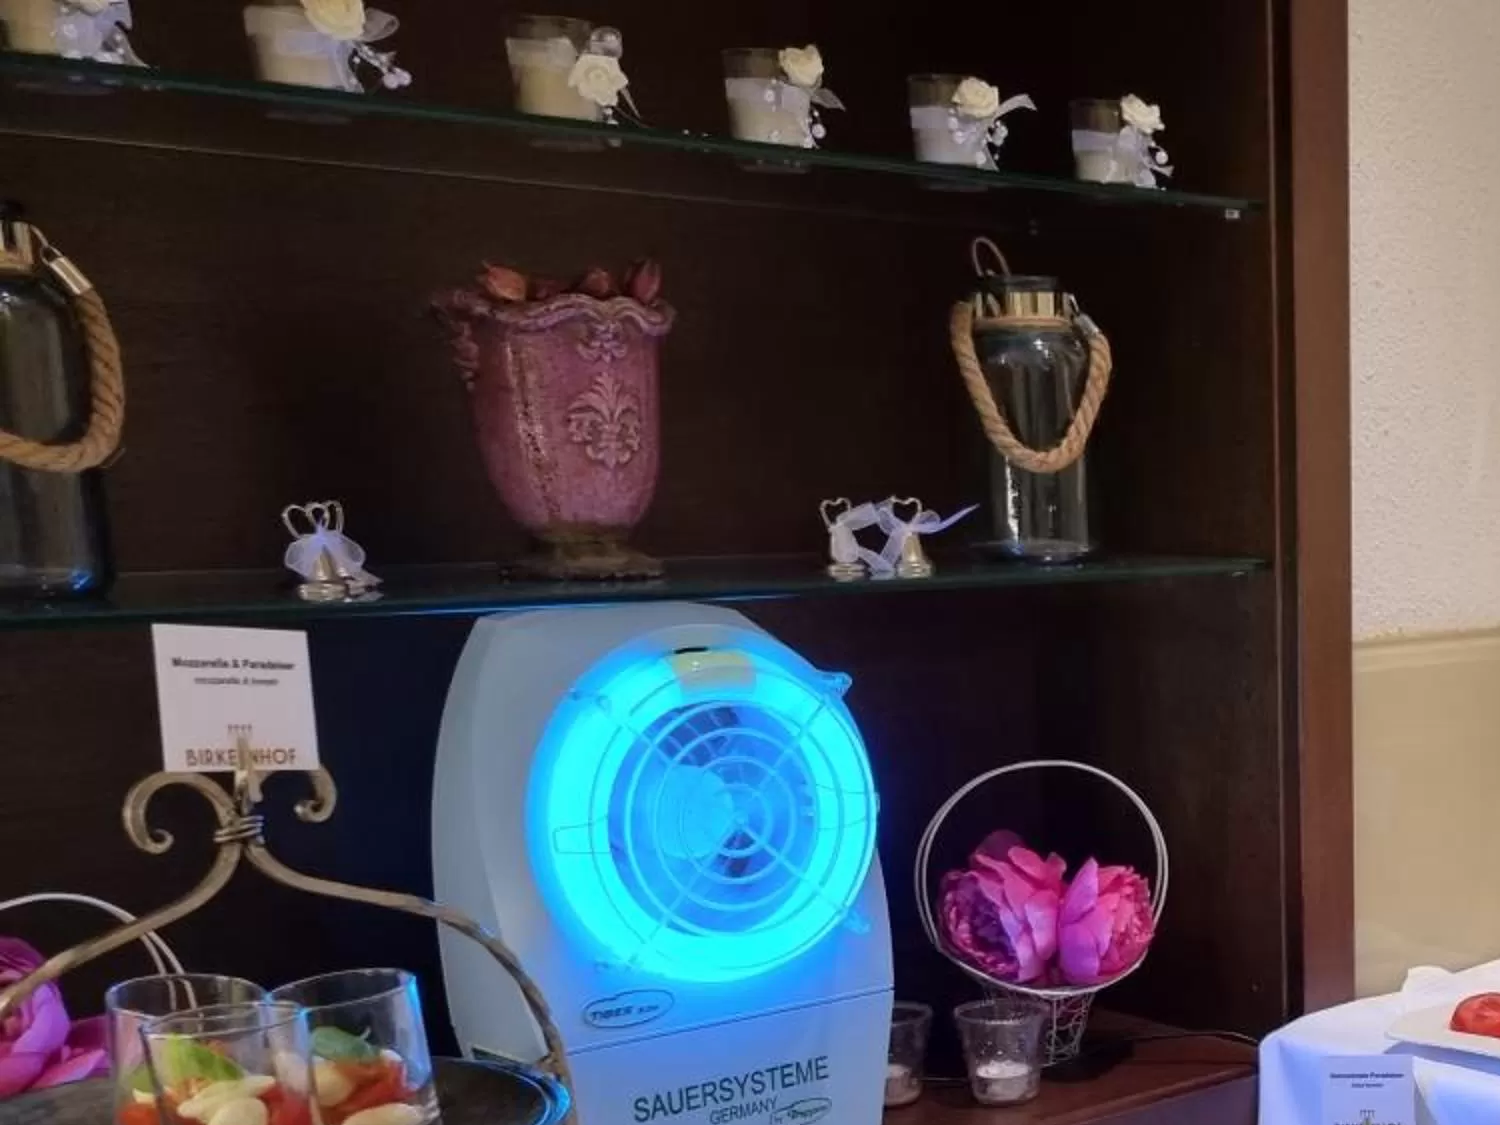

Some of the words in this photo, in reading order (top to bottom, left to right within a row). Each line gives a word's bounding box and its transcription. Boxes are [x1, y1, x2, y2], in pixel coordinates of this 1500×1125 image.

[172, 657, 229, 669] Mozzarella
[633, 1056, 829, 1123] SAUERSYSTEME
[709, 1096, 778, 1125] GERMANY
